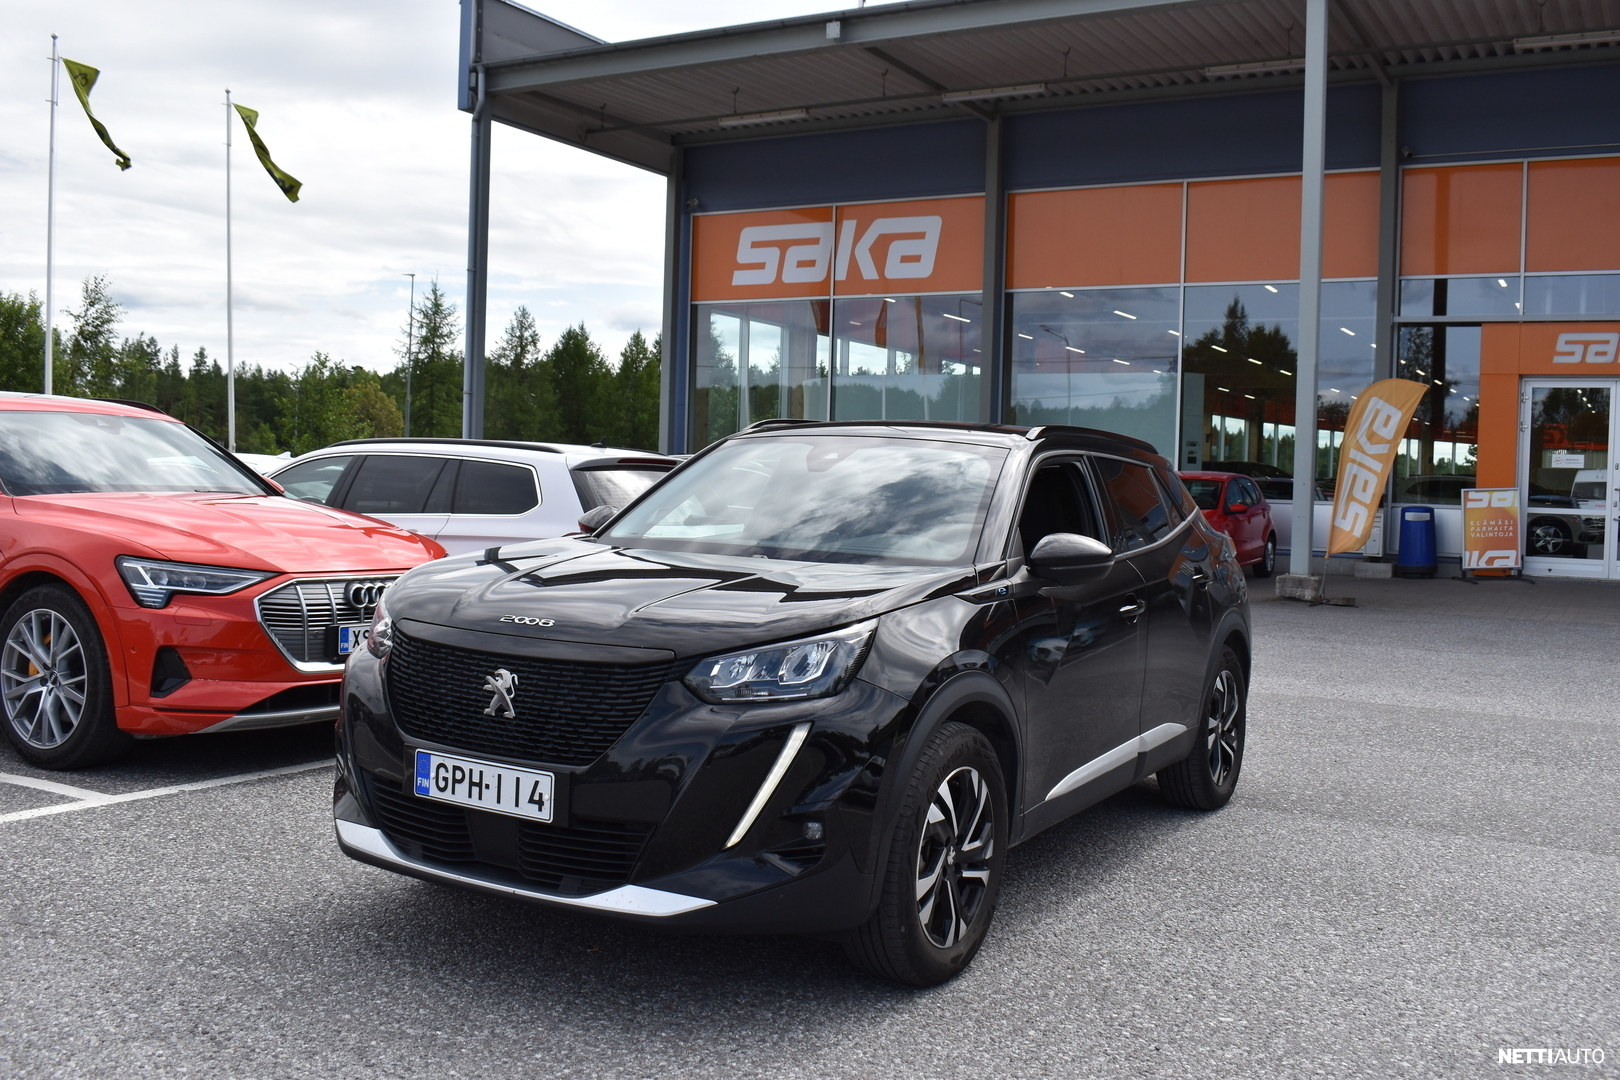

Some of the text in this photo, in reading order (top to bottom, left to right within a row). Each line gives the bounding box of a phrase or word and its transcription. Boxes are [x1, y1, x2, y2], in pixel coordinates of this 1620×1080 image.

[1552, 332, 1620, 364] sa
[499, 614, 556, 627] 2008
[417, 777, 430, 788] FIN
[435, 762, 545, 812] GPH-114
